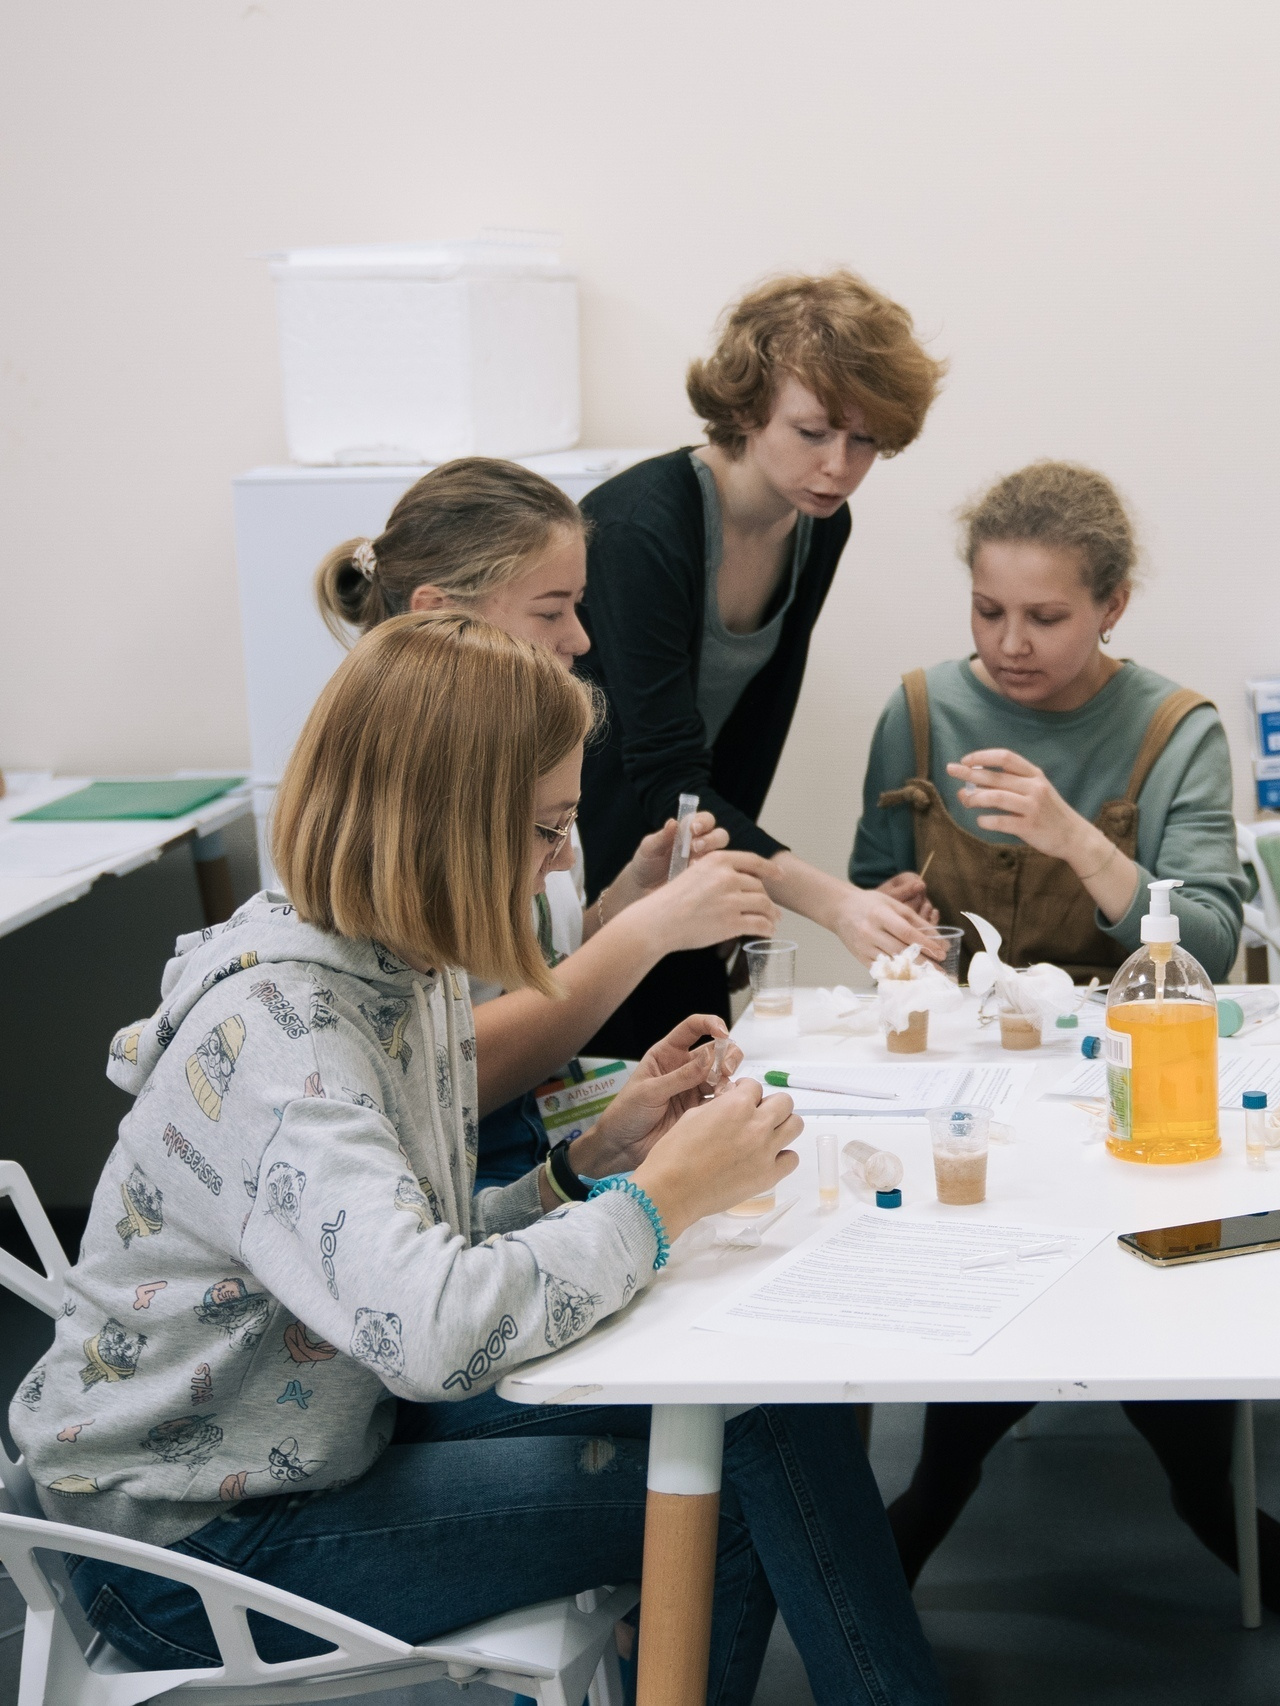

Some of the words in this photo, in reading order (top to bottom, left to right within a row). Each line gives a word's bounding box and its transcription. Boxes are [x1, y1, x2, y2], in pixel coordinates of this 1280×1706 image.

[567, 1078, 615, 1100] АЛЬТАИР
[162, 1122, 223, 1196] HYPEBEASTS
[442, 1314, 518, 1391] COOL
[190, 1362, 214, 1407] STAR
